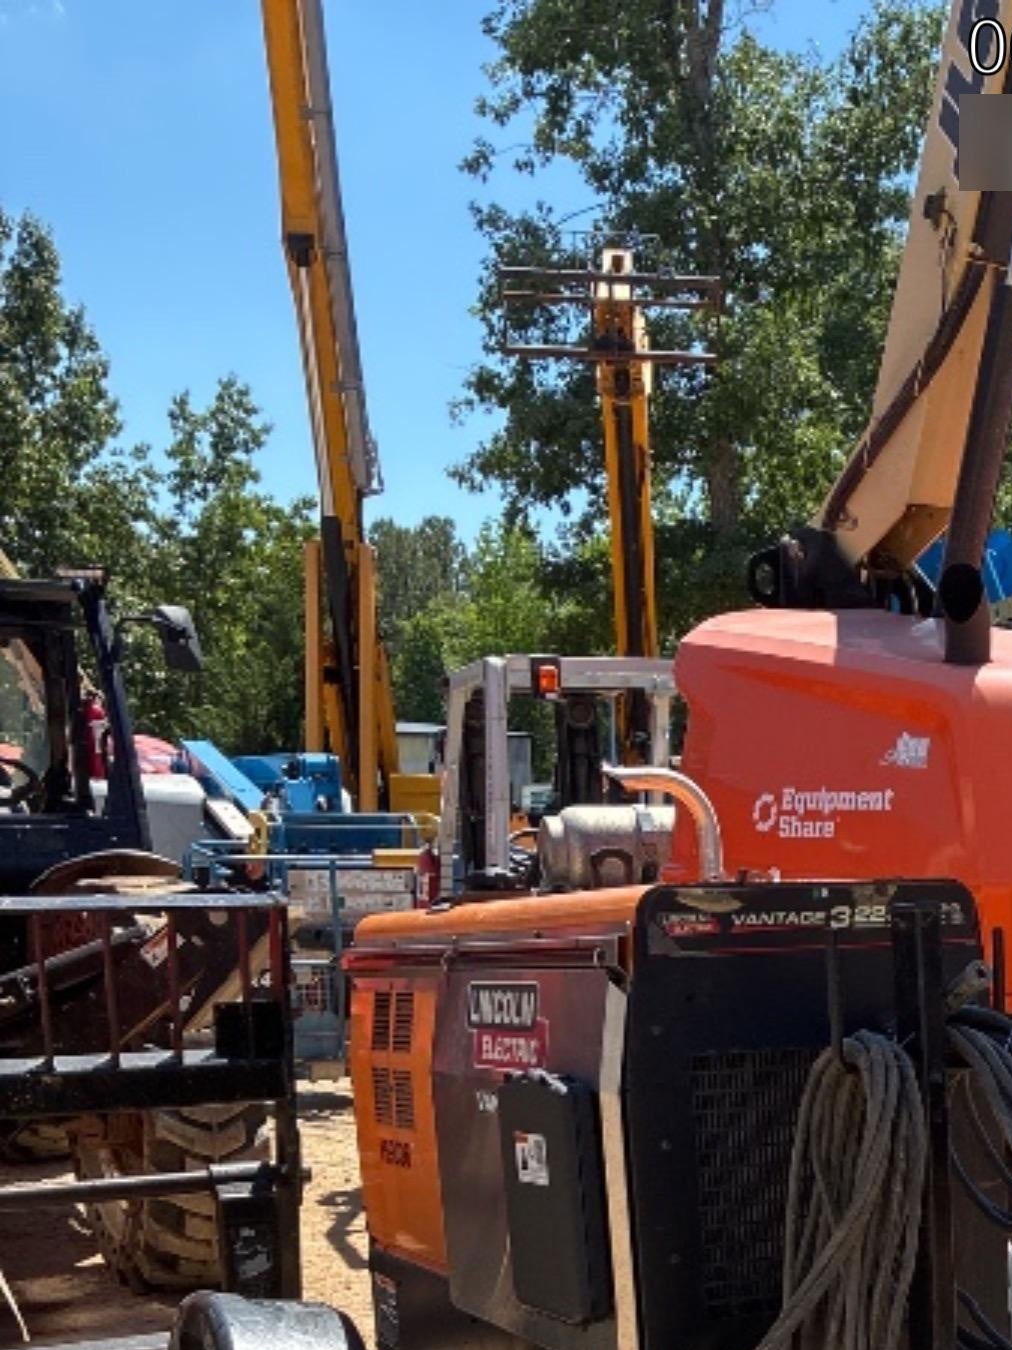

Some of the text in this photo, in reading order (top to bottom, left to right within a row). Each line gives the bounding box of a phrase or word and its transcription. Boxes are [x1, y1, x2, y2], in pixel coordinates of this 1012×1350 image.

[782, 785, 895, 815] Equipment
[778, 815, 836, 838] Share
[731, 911, 826, 925] VANTAGE
[470, 989, 536, 1027] LINCOLN
